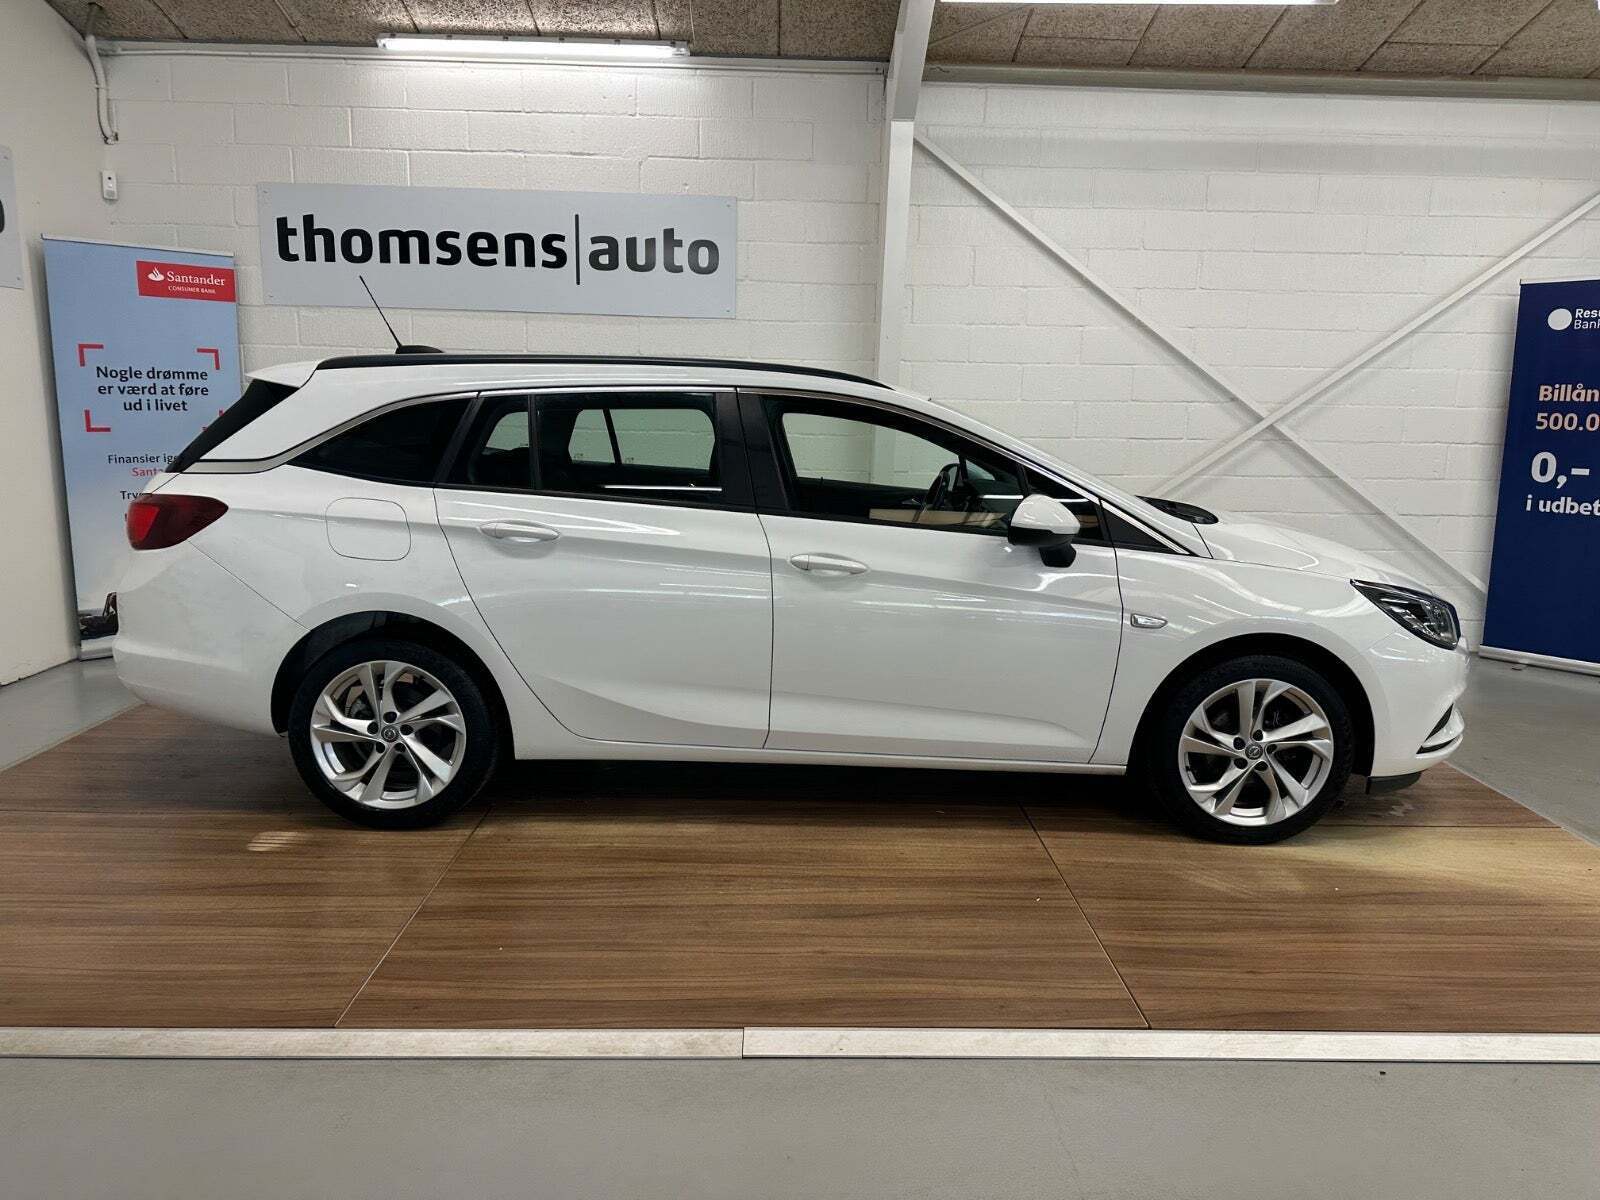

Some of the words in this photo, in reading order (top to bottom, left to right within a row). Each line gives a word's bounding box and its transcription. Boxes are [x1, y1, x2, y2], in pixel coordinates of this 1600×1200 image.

[588, 227, 719, 275] auto
[167, 270, 226, 286] Santander
[168, 285, 201, 293] CONSUMER
[1575, 308, 1600, 318] Res
[96, 366, 143, 382] Nogle
[146, 367, 208, 381] drømme
[97, 385, 114, 395] er
[117, 383, 157, 396] værd
[160, 385, 175, 396] at
[179, 384, 209, 397] føre
[1538, 383, 1600, 402] Billån
[123, 399, 146, 411] ud
[146, 399, 151, 411] i
[155, 399, 188, 411] livet
[1535, 412, 1600, 432] 500.0
[107, 453, 161, 464] Finansier
[119, 490, 143, 501] Try
[1525, 494, 1533, 511] i
